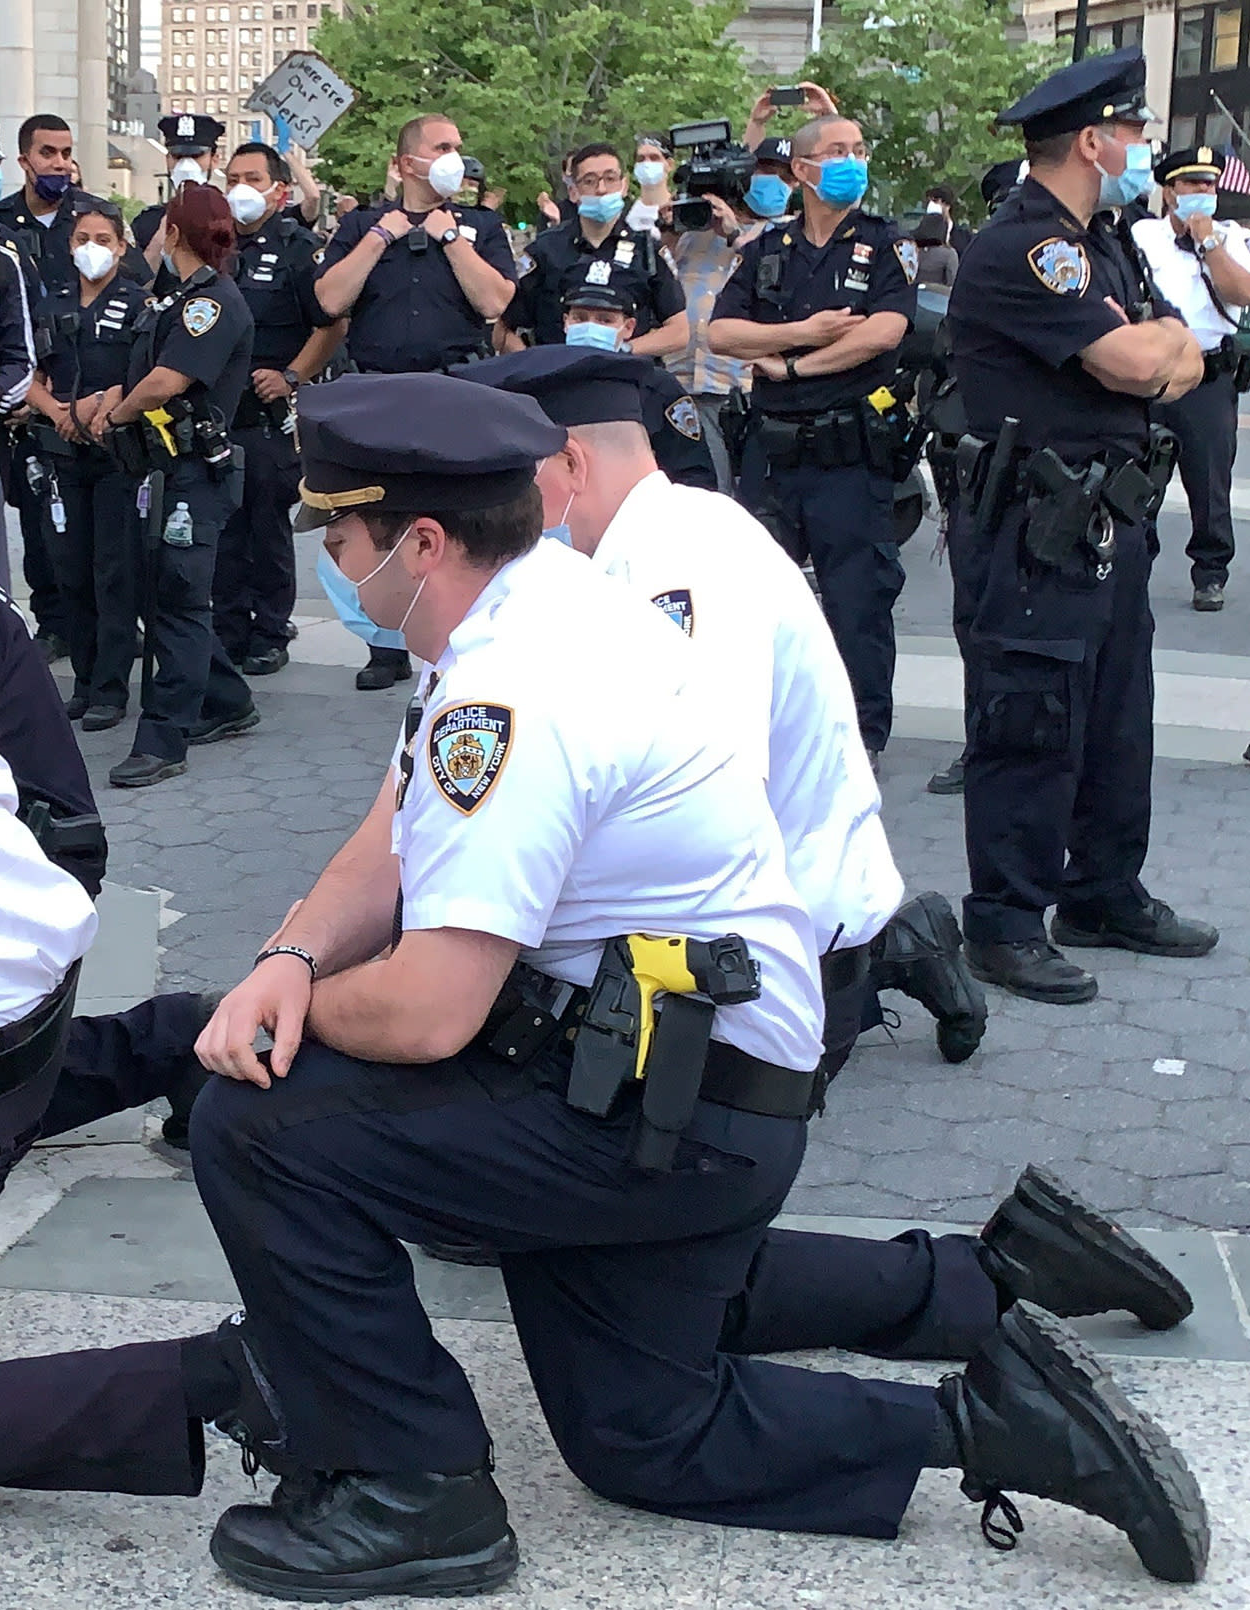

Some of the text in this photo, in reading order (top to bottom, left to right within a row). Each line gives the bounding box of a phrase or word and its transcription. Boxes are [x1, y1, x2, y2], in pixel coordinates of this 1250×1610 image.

[433, 718, 505, 743] DEPARTMENT
[447, 706, 486, 723] POLICE
[432, 756, 457, 797] CITY OF
[471, 741, 506, 799] NEW YORK
